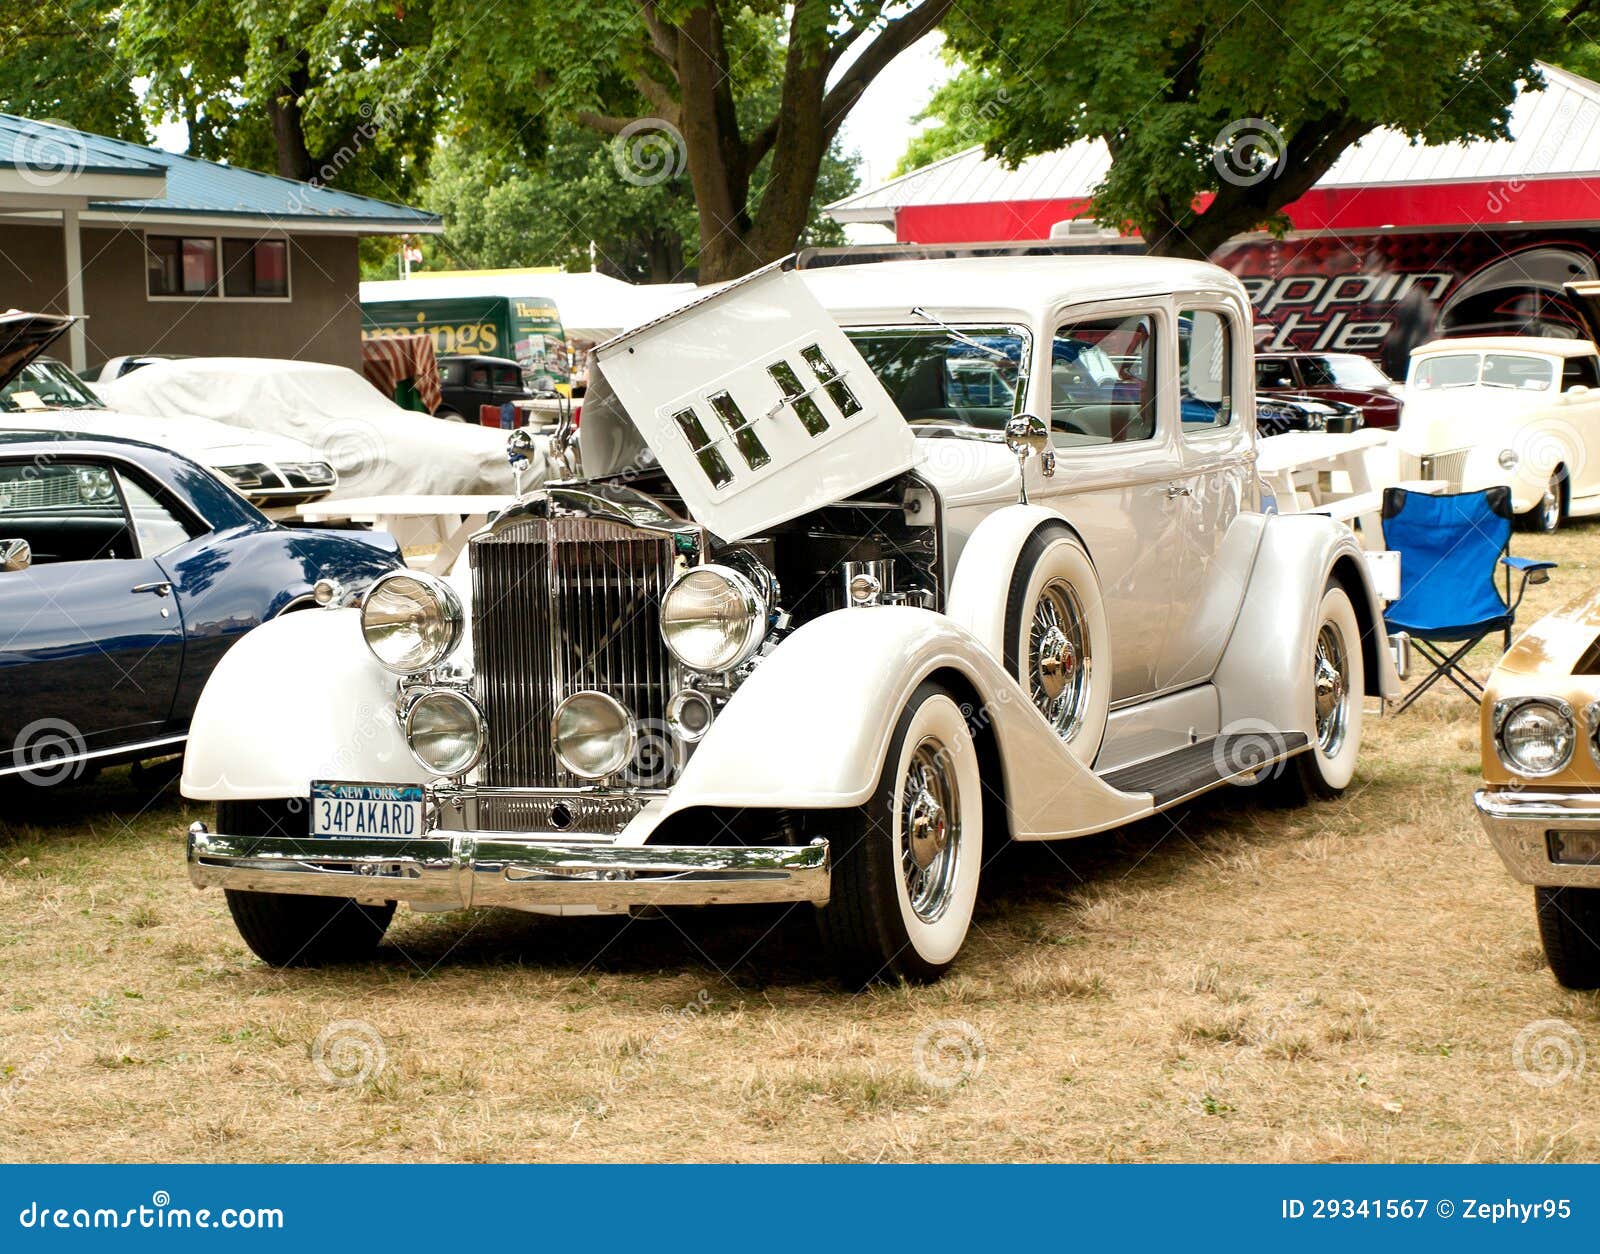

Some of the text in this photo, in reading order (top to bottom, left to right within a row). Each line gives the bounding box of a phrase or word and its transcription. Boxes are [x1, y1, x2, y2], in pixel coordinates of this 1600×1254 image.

[340, 786, 398, 801] NEW YORK
[321, 800, 415, 835] 34PAKARD
